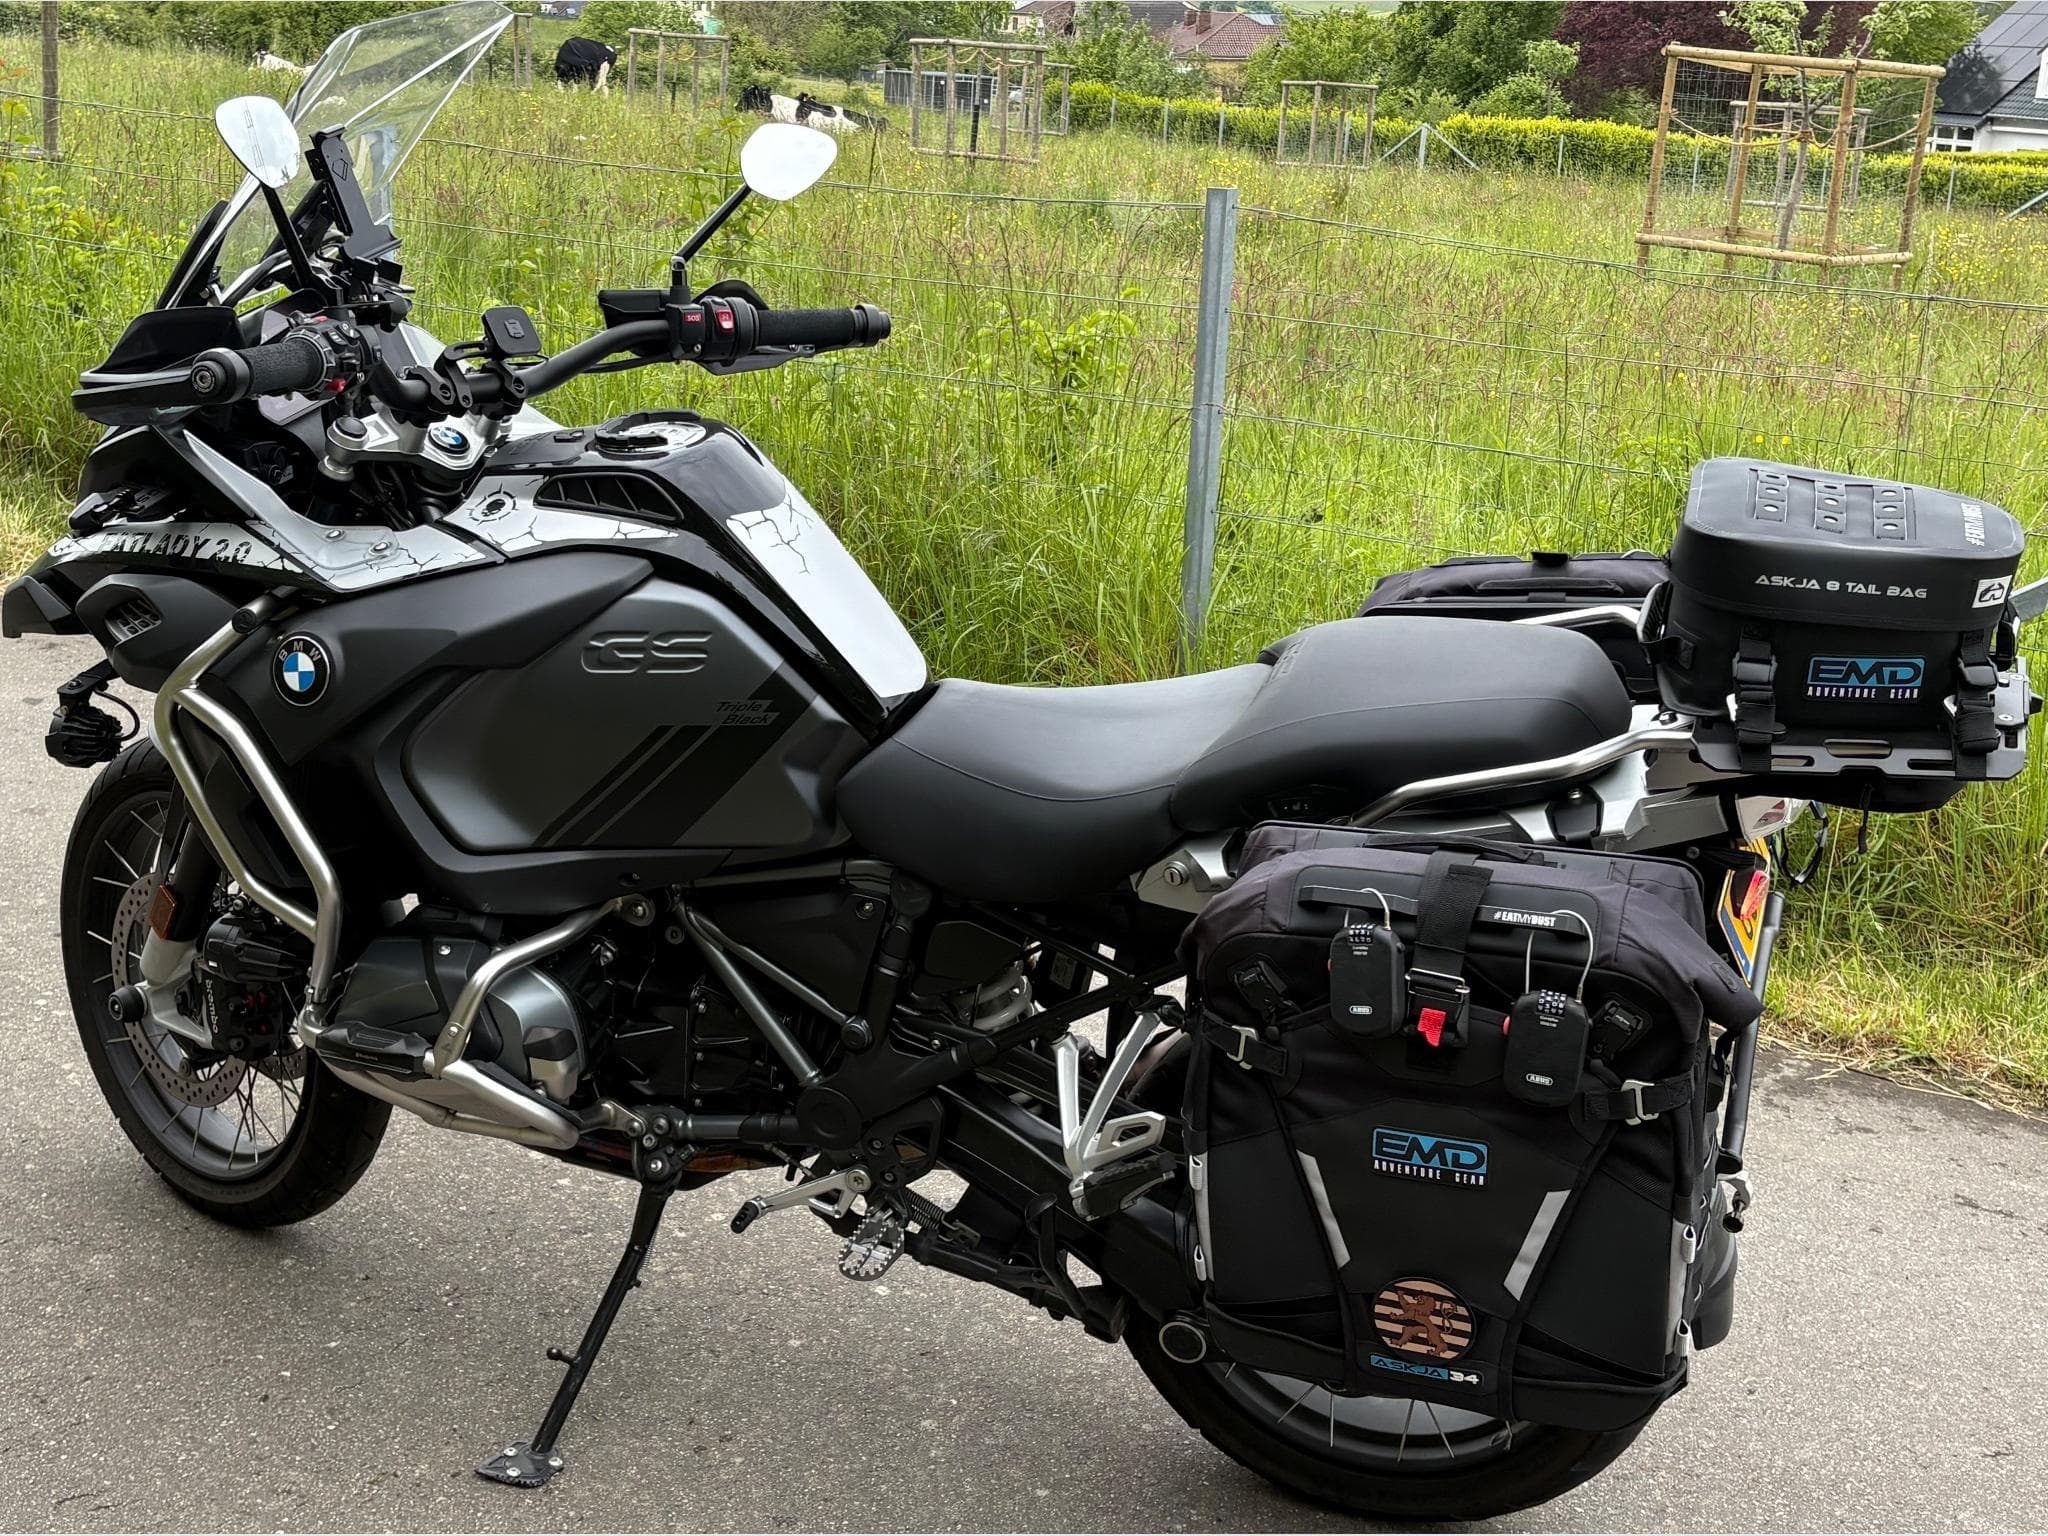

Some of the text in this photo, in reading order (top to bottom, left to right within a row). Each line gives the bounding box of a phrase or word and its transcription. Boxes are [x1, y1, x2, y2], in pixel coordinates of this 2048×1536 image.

[1754, 574, 1928, 599] ASKJA 8 TAIL BAG
[278, 640, 322, 662] BMW
[581, 631, 712, 674] GS
[1811, 659, 1922, 685] EMD
[1807, 686, 1919, 699] ADVENTURE GEAR
[716, 701, 762, 714] Triple
[721, 713, 769, 725] Black
[1493, 911, 1557, 927] #EATMYDUST
[205, 979, 219, 1034] brembo
[1374, 1130, 1486, 1171] EMD
[1373, 1159, 1484, 1186] ADVENTURE GEAR
[1374, 1358, 1480, 1385] ASKJA 34
